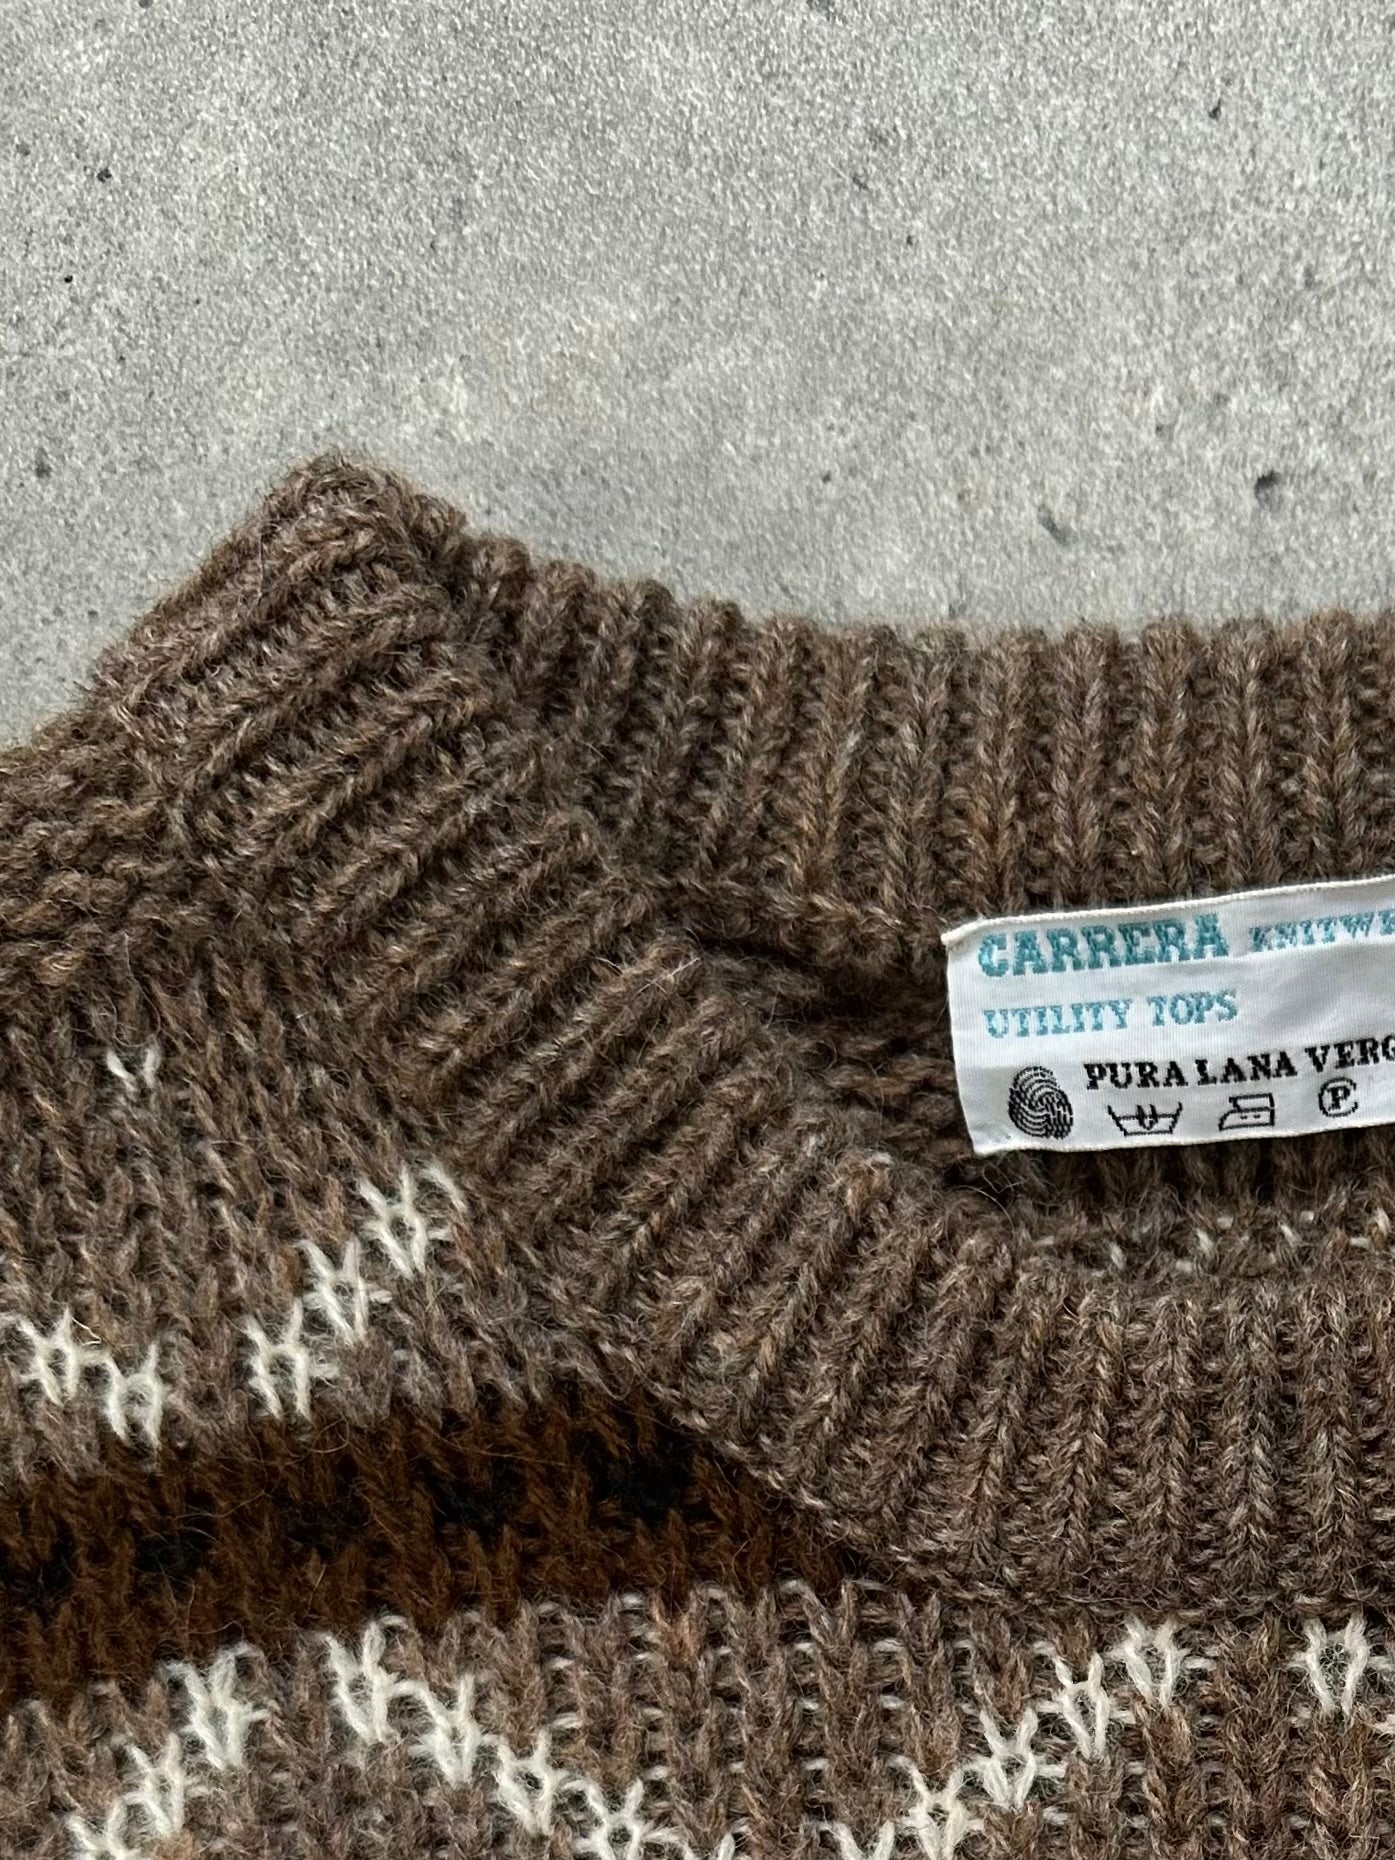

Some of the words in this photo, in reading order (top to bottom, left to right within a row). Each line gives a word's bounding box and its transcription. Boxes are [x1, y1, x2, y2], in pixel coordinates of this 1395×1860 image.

[977, 913, 1229, 978] CARRERA
[984, 998, 1133, 1039] UTILITY
[1147, 988, 1239, 1027] TOPS
[1084, 1060, 1188, 1091] PURA
[1196, 1049, 1298, 1085] LANA
